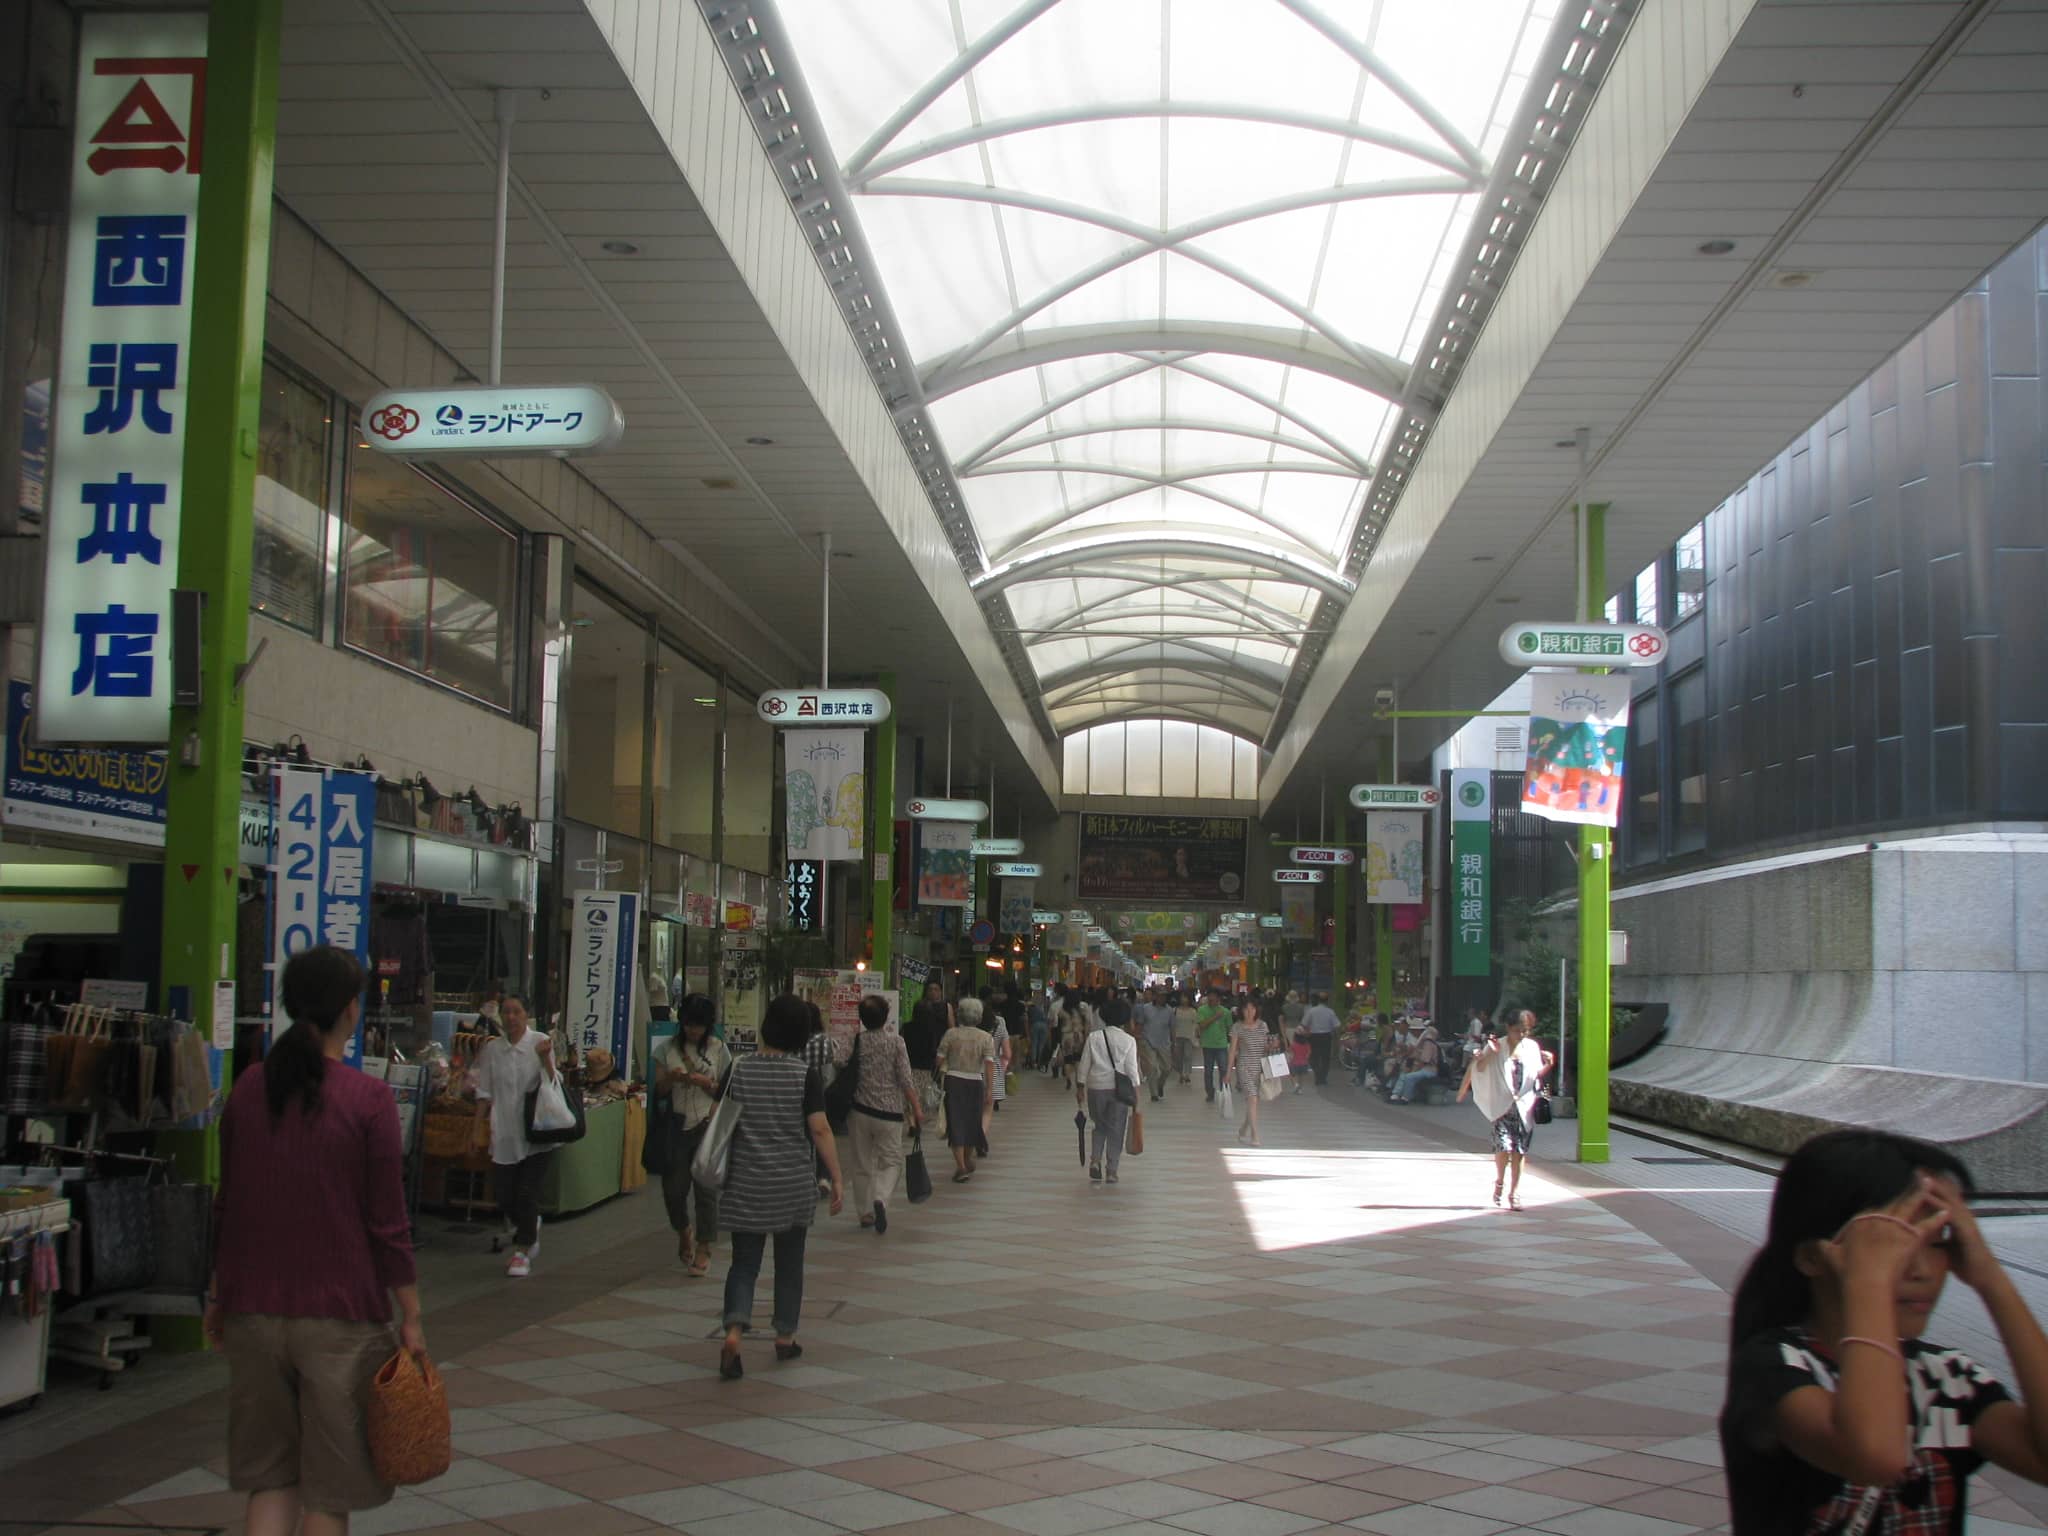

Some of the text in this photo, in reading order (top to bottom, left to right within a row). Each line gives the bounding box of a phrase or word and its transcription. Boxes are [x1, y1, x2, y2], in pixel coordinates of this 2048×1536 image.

[468, 412, 583, 434] ランドアーク
[72, 215, 187, 698] 西沢本店
[1541, 633, 1624, 654] 親和銀行
[821, 702, 873, 716] 西沢本店
[1371, 789, 1418, 802] 親和銀行
[1459, 853, 1483, 944] 親和銀行
